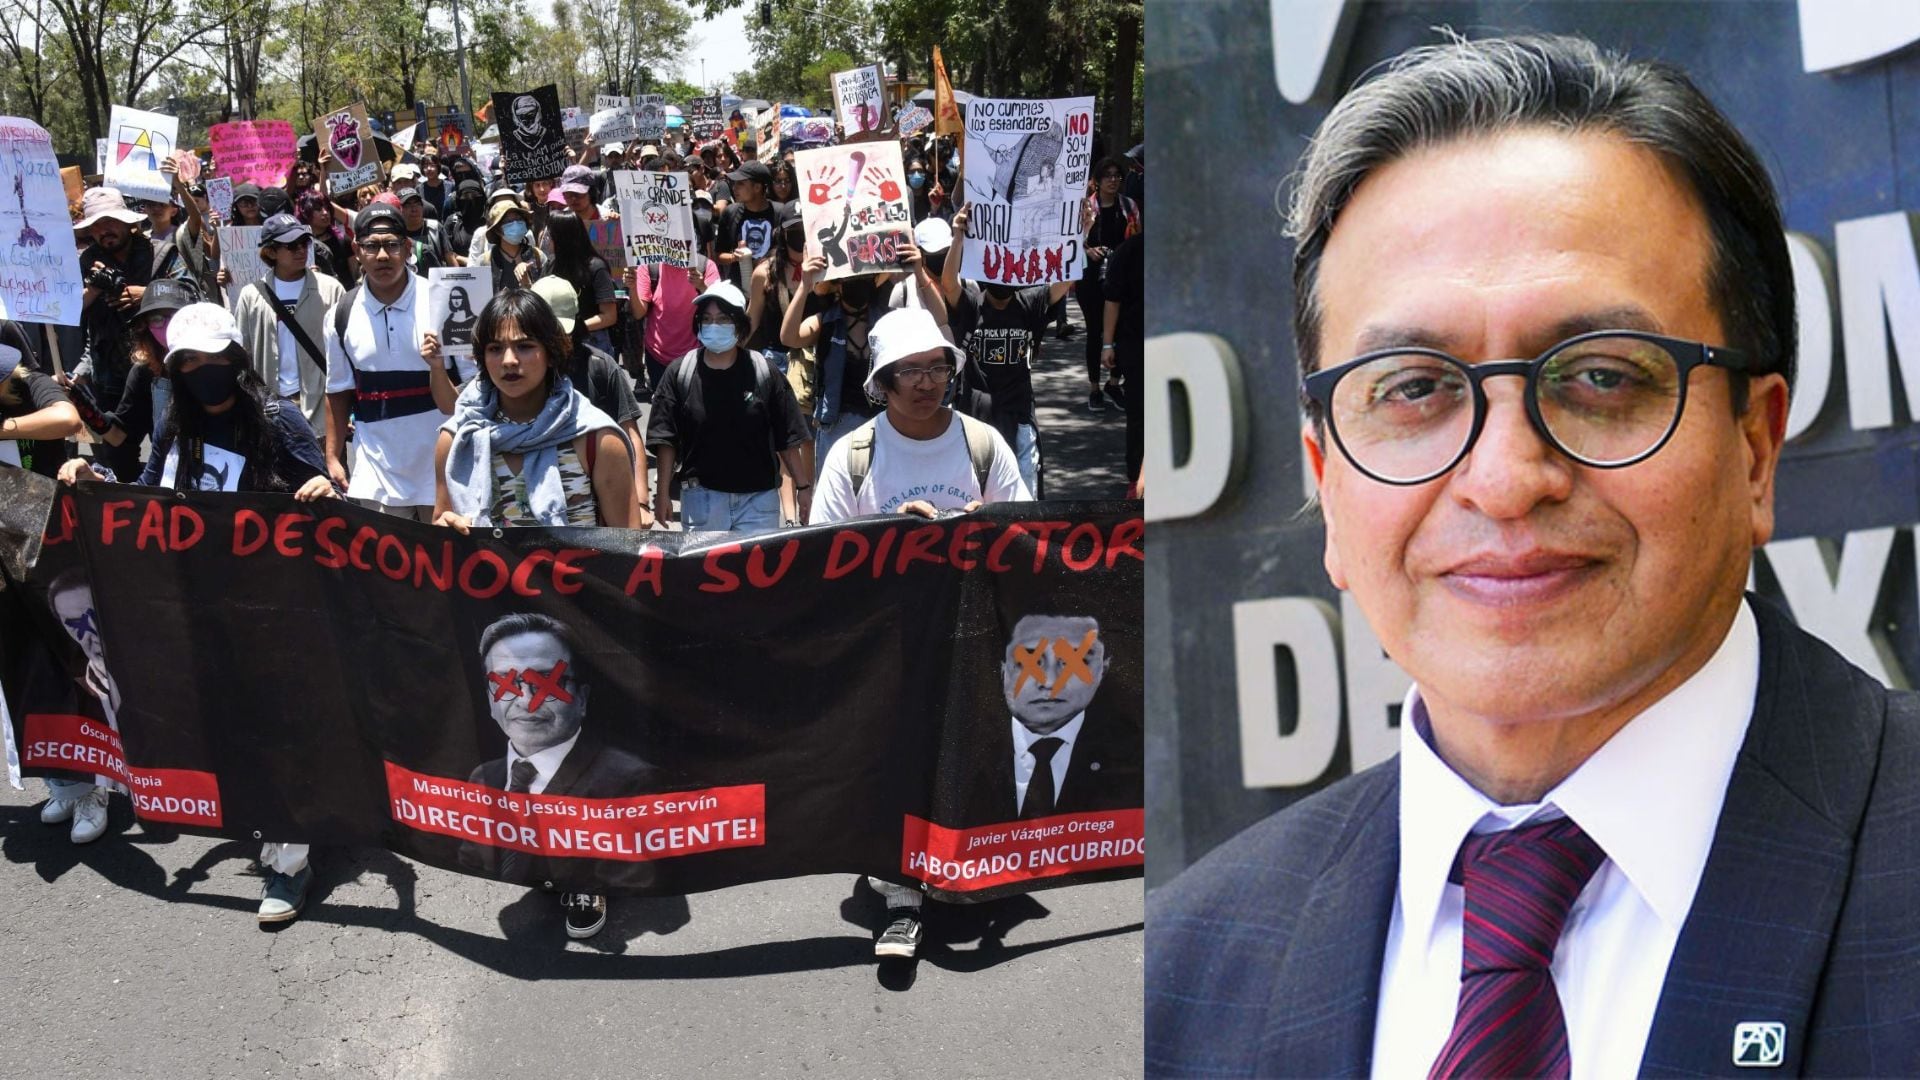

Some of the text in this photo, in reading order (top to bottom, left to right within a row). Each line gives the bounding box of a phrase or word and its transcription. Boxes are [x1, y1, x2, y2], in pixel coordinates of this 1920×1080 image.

[974, 103, 994, 117] NO
[989, 116, 1051, 131] estandares
[1064, 113, 1089, 137] ¡NO
[631, 172, 678, 189] LA FAD
[648, 186, 687, 206] GRANDE
[851, 203, 908, 226] ORGULLO
[984, 328, 998, 337] PICK
[1000, 328, 1008, 337] UP
[881, 496, 900, 513] OUR
[901, 485, 928, 499] LADY
[932, 484, 945, 494] OF
[102, 500, 205, 552] FAD
[232, 509, 598, 598] DESCONOCE
[625, 544, 664, 596] A
[698, 539, 799, 593] SU
[823, 518, 1144, 580] DIRECTOR
[80, 722, 108, 743] Óscar
[128, 772, 162, 788] Tapia
[413, 777, 718, 821] Mauricio de Jesús Juárez Servín
[394, 798, 758, 855] ¡DIRECTOR NEGLIGENTE!
[967, 819, 1115, 851] Javier Vázquez Ortega
[909, 852, 1022, 881] ¡ABOGADO
